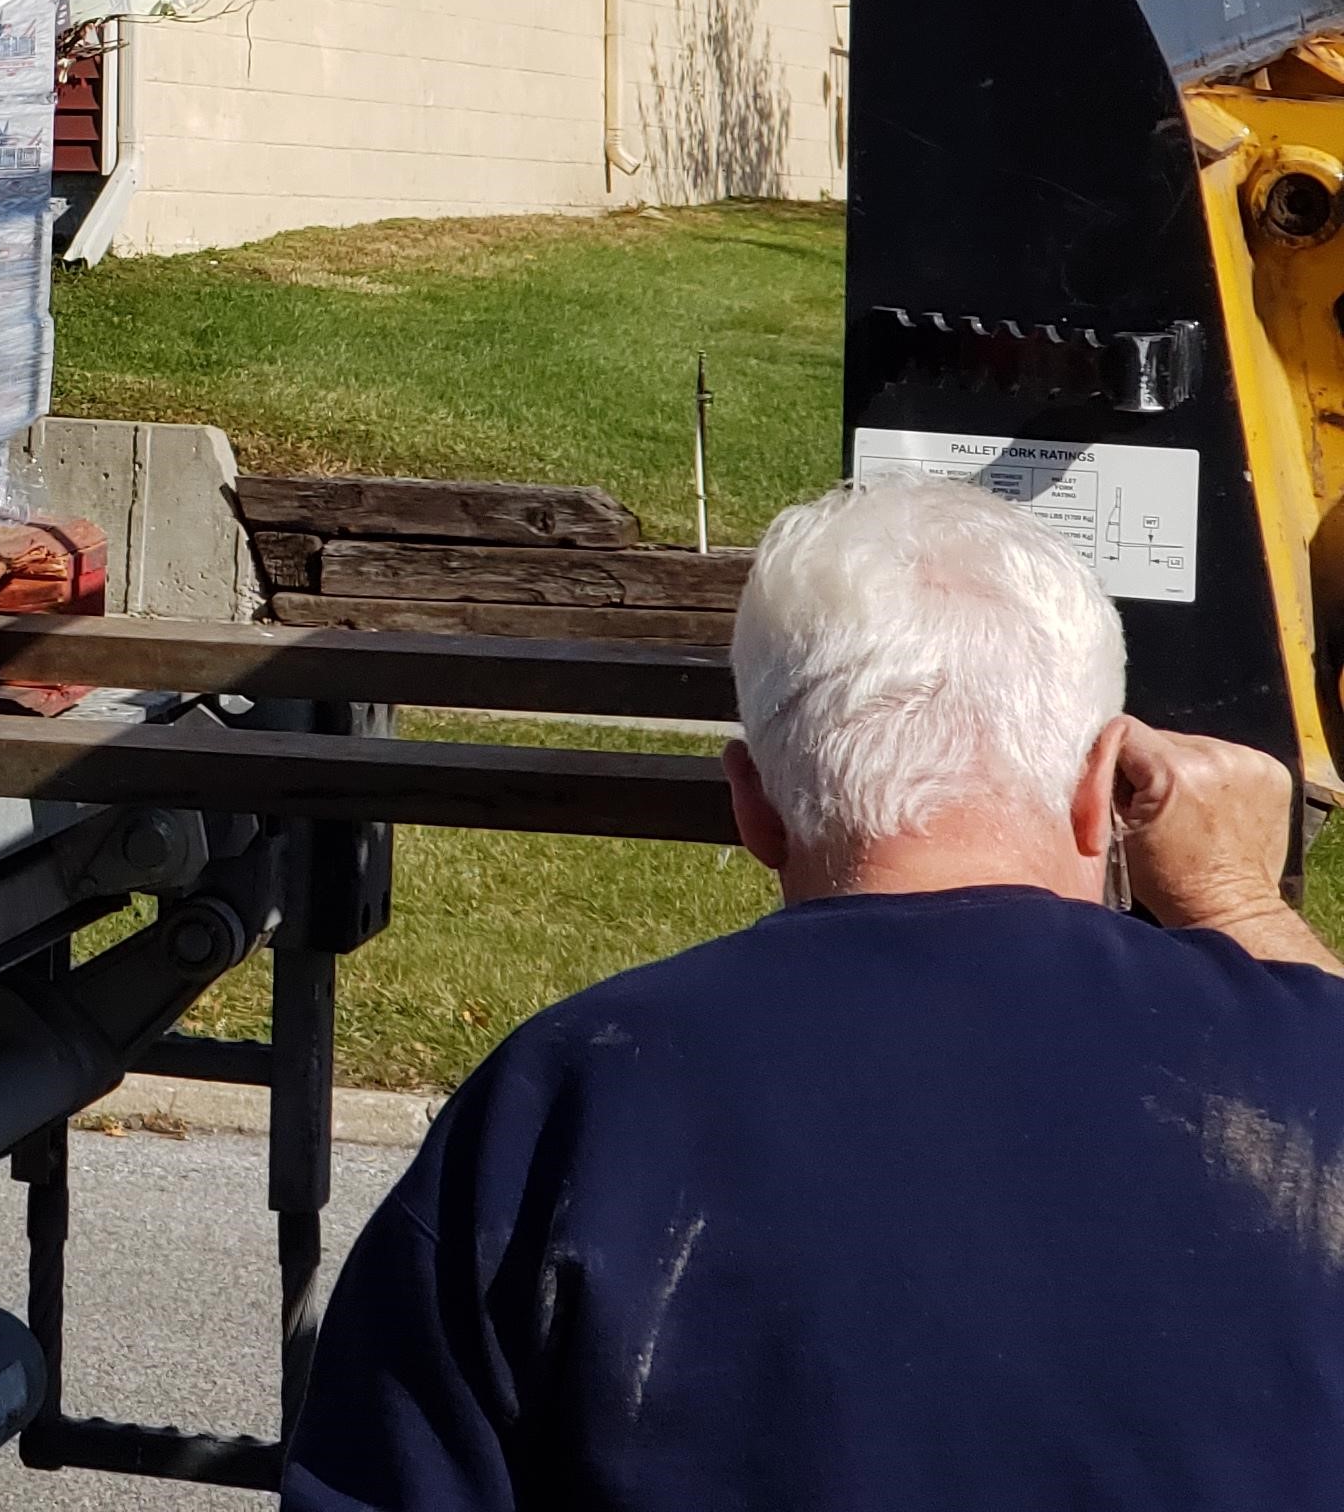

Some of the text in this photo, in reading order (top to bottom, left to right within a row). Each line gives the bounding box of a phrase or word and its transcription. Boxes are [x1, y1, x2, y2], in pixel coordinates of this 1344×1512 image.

[950, 443, 1095, 463] PALLET FORK RATINGS
